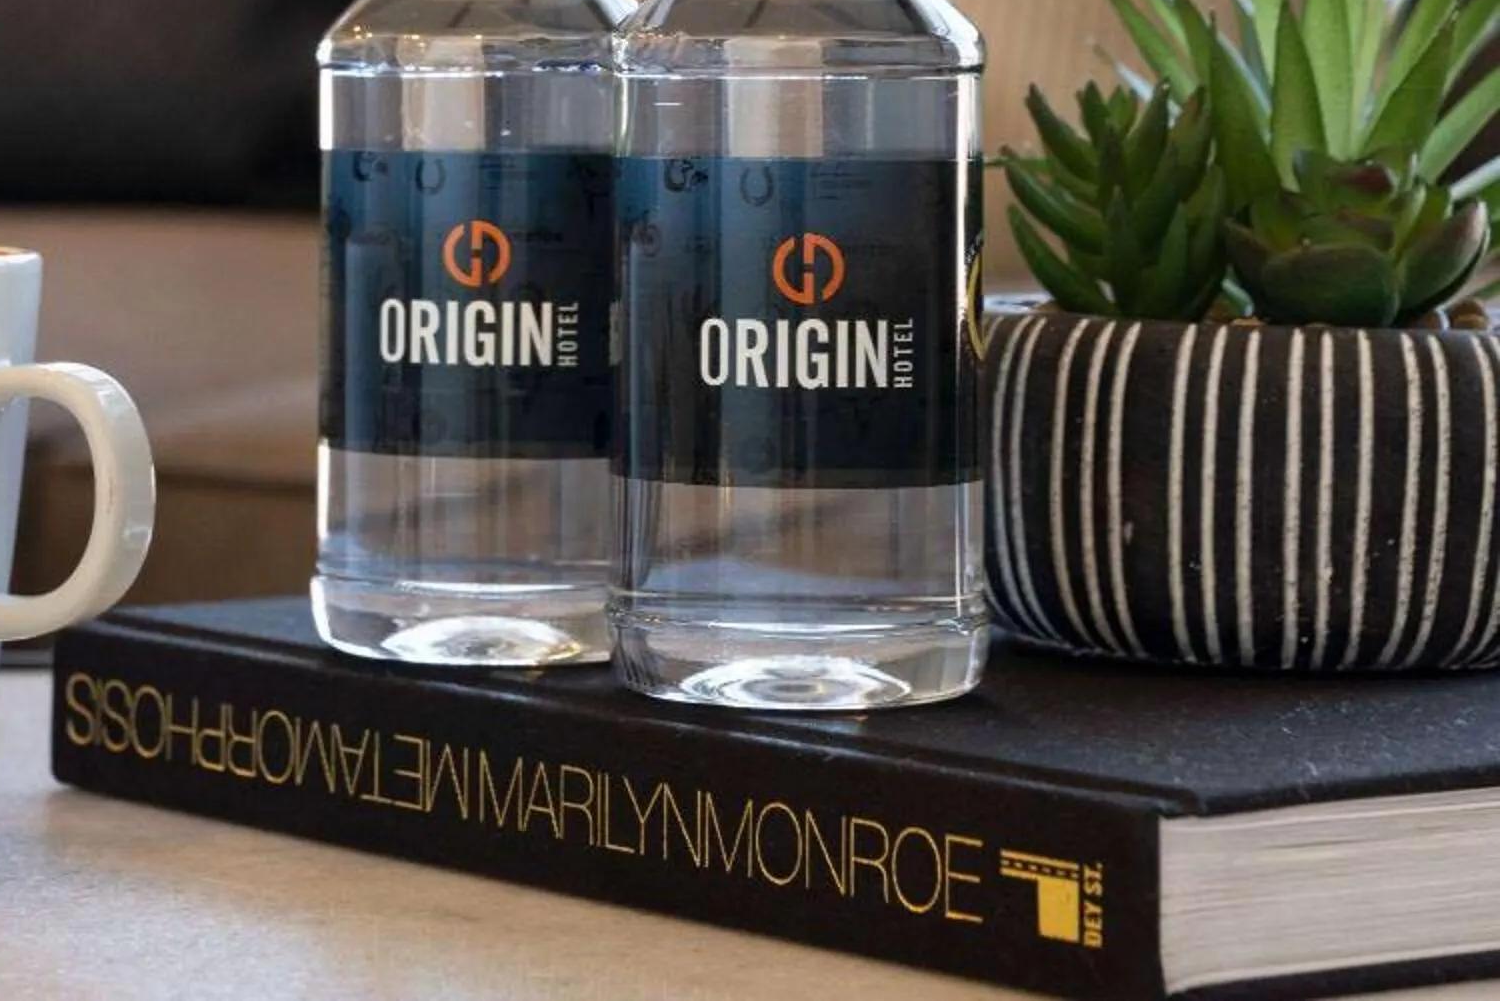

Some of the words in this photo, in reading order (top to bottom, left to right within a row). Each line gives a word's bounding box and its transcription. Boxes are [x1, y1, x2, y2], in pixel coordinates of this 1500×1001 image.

[380, 298, 553, 367] ORIGIN
[557, 302, 578, 367] HOTEL
[700, 317, 888, 390] ORIGIN
[893, 318, 913, 388] HOTEL
[65, 671, 469, 820] METAMORPHOSIS
[1083, 900, 1103, 948] DEY
